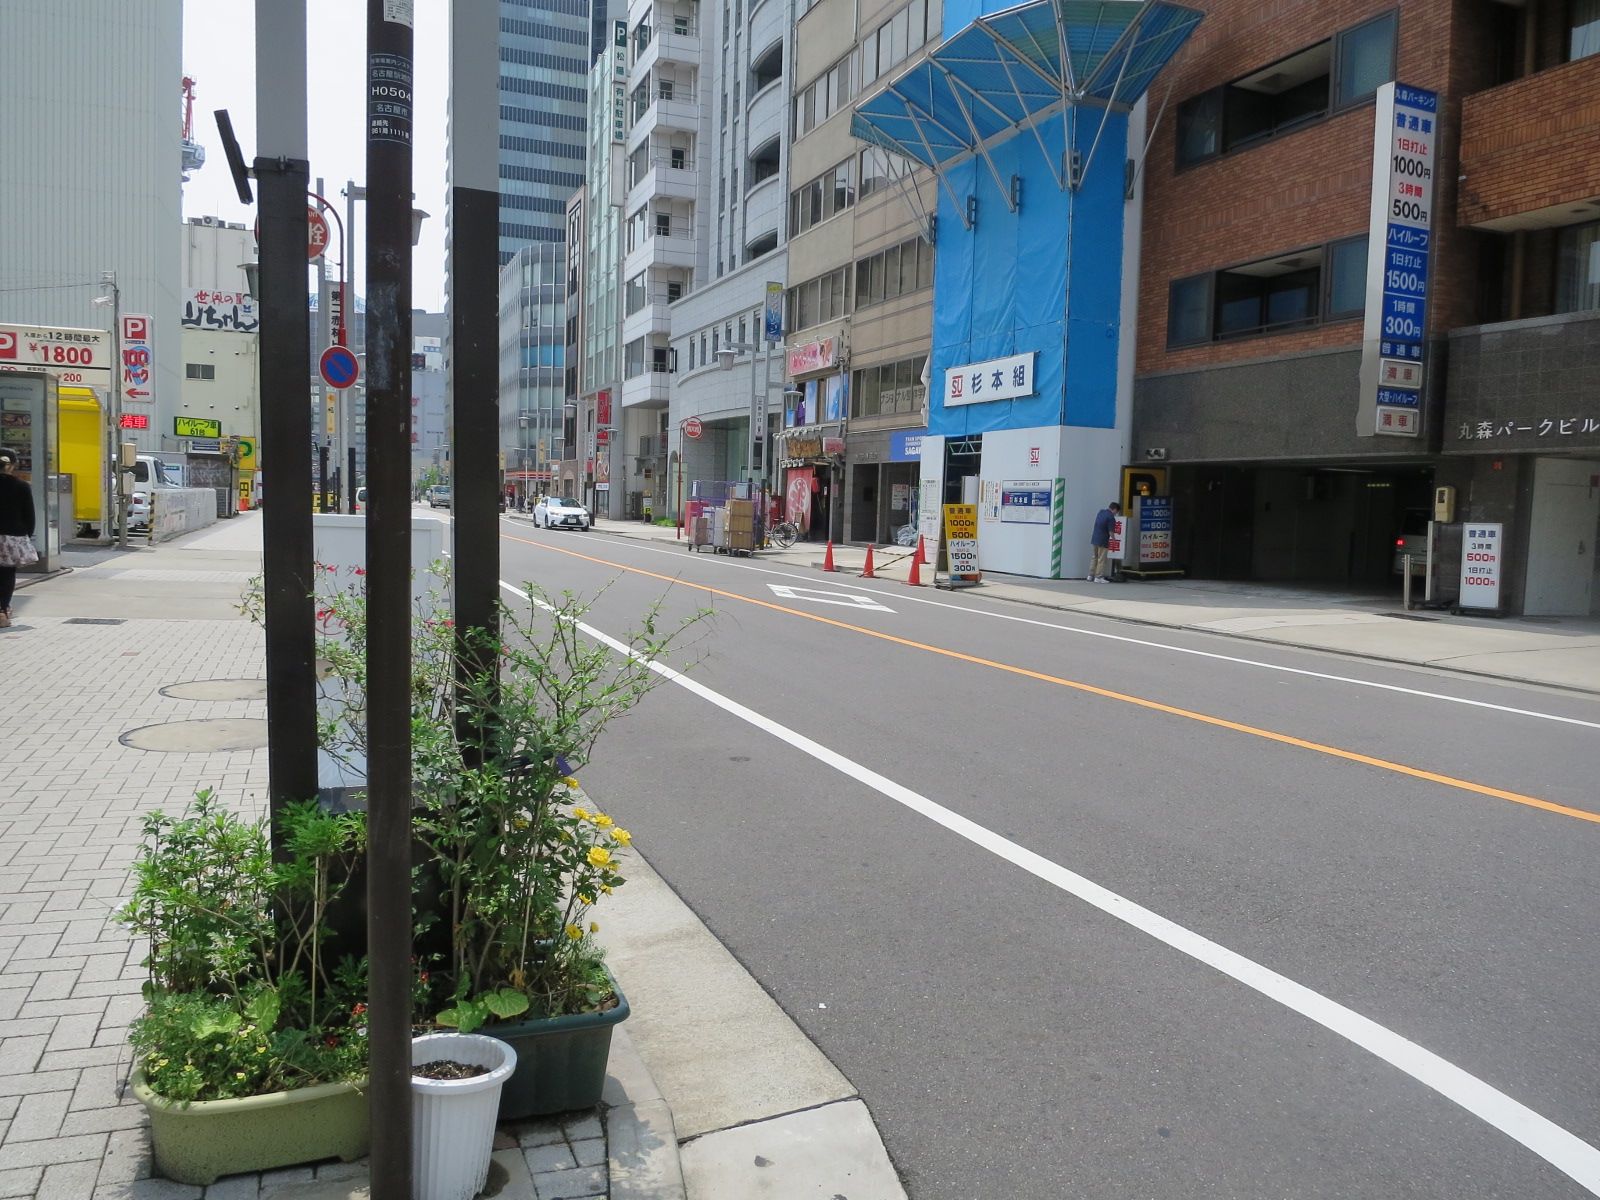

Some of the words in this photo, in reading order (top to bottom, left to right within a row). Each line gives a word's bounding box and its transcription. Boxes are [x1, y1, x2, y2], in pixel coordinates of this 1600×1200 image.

[617, 27, 626, 40] P
[376, 103, 408, 116] 名古屋市
[1396, 112, 1432, 135] 普通車
[1398, 138, 1428, 156] 1日打止
[1393, 155, 1431, 180] 1000円
[1398, 182, 1423, 199] 3時間
[1393, 199, 1427, 222] 500円
[1388, 227, 1428, 248] ハイルーフ
[1392, 252, 1422, 269] 1日打止
[1386, 269, 1425, 293] 1500円
[1392, 300, 1415, 314] 1時間
[126, 319, 144, 338] P
[1386, 317, 1421, 338] 300円
[1382, 342, 1420, 358] 普通車
[952, 376, 964, 398] SU
[971, 364, 1025, 395] 杉本組
[1387, 366, 1413, 381] 満車
[120, 414, 147, 428] 満車
[1382, 413, 1408, 427] 満車
[1458, 418, 1600, 440] 丸森パークビル
[1030, 450, 1040, 461] SU
[1469, 530, 1496, 539] 普通車
[1468, 566, 1494, 574] 1日打止
[1464, 576, 1496, 586] 1000円
